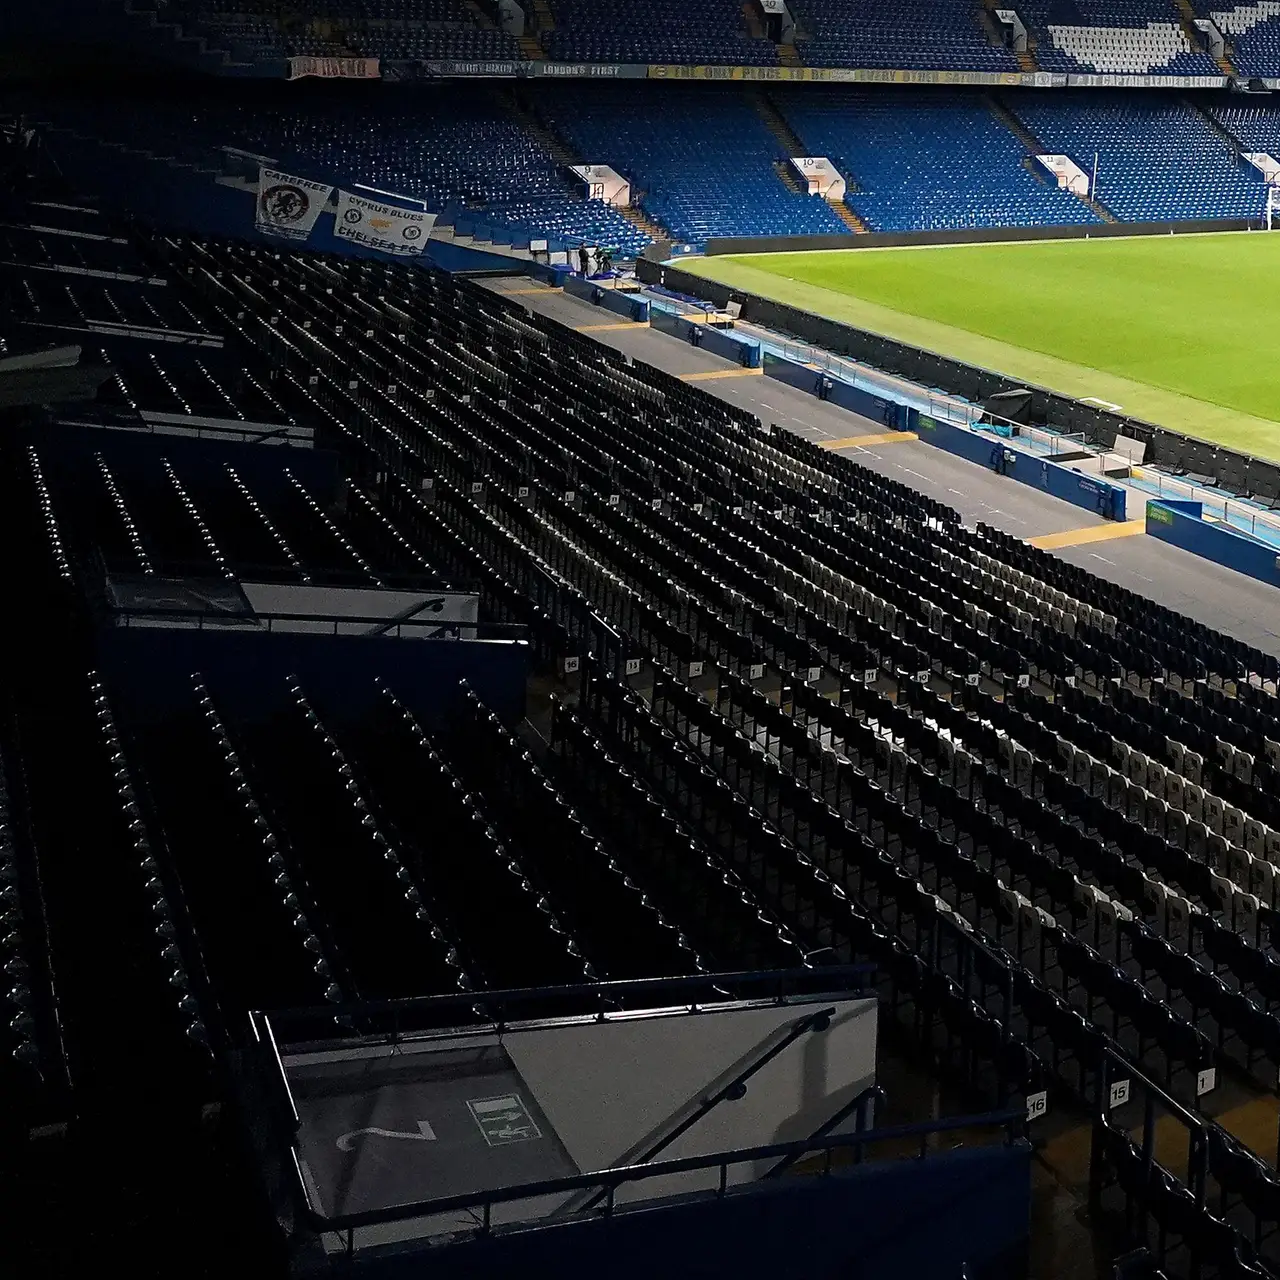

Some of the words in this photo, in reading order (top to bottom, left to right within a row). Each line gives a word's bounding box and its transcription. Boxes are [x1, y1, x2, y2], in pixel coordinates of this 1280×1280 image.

[543, 64, 586, 75] LONDON'S
[590, 65, 620, 75] FIRST
[803, 158, 813, 166] 10
[584, 166, 591, 174] 9
[264, 170, 327, 193] CAREFREE
[350, 196, 388, 214] CYPRUS
[390, 209, 424, 221] BLUES
[338, 226, 399, 250] CHELSEA
[400, 243, 417, 254] FC
[566, 660, 577, 669] 16
[867, 672, 874, 680] 11
[919, 673, 926, 681] 10
[971, 676, 976, 684] 9
[1112, 1085, 1126, 1099] 15
[1030, 1098, 1045, 1112] 16
[335, 1119, 437, 1153] 2
